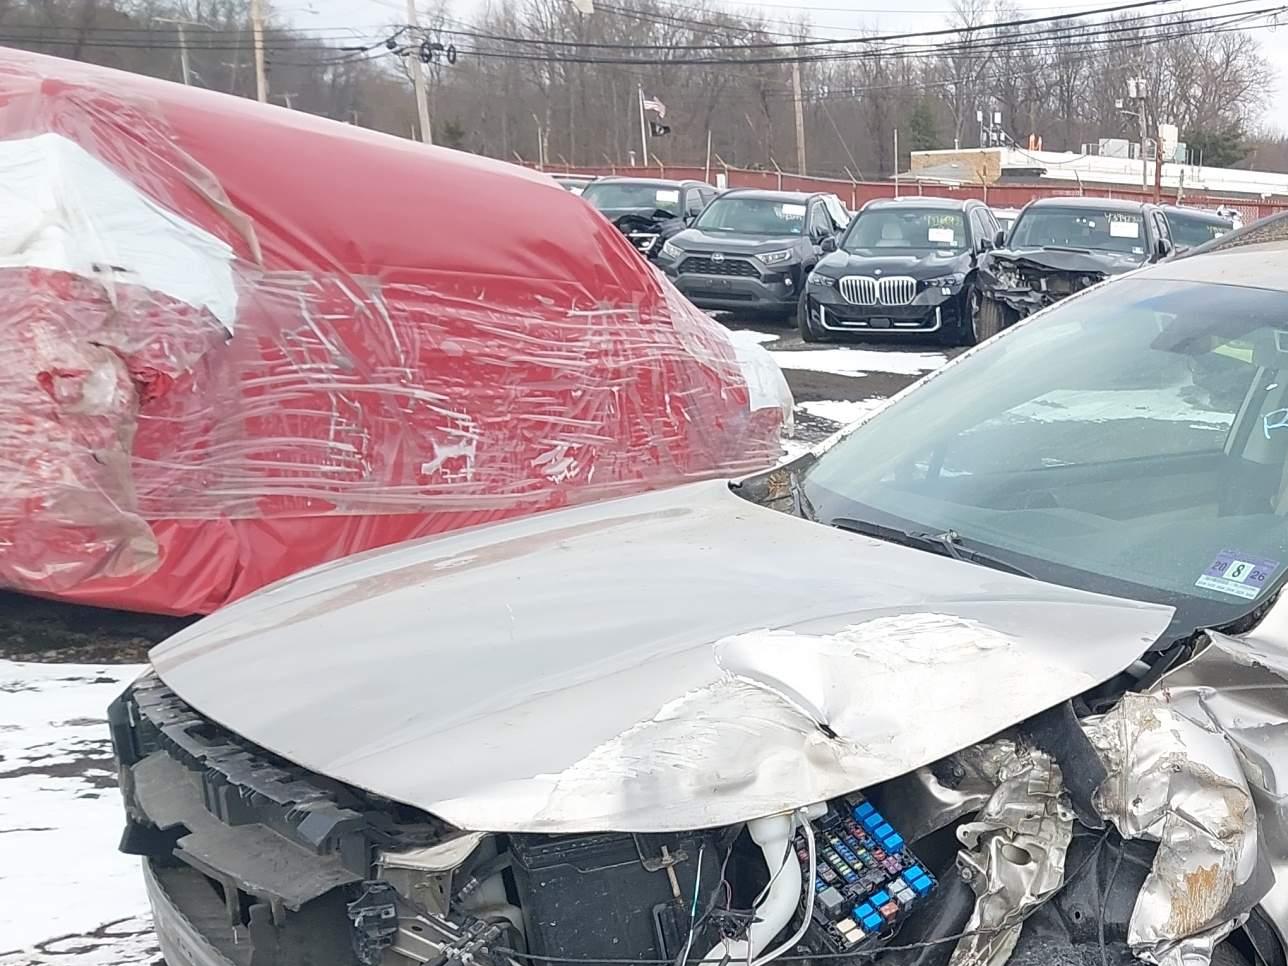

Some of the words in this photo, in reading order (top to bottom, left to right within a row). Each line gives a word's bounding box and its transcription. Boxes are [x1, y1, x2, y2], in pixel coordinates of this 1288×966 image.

[1211, 560, 1228, 572] 20
[1231, 564, 1246, 578] 8
[1249, 570, 1266, 582] 26
